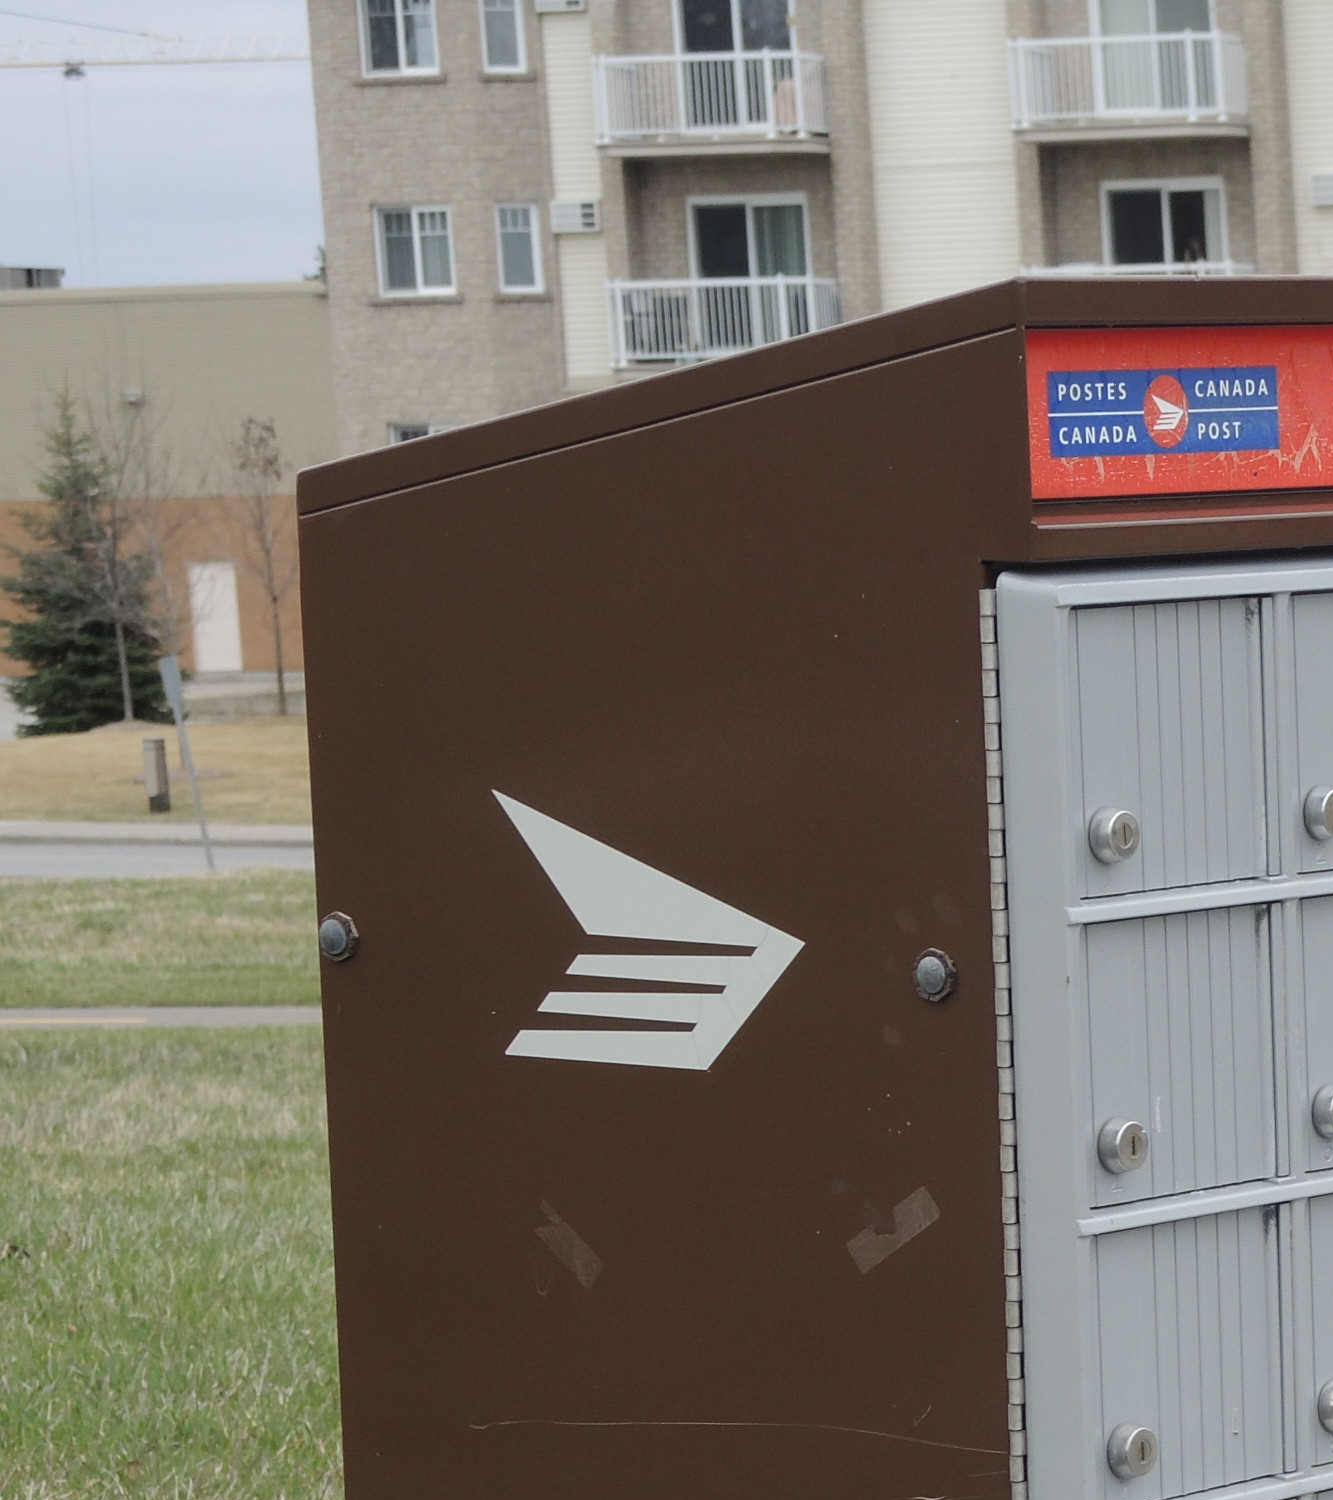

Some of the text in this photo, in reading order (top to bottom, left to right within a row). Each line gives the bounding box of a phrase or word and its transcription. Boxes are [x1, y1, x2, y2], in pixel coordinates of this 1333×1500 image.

[1058, 382, 1127, 401] POSTES
[1194, 379, 1269, 398] CANADA
[1059, 425, 1137, 445] CANADA
[1198, 421, 1241, 440] POST
